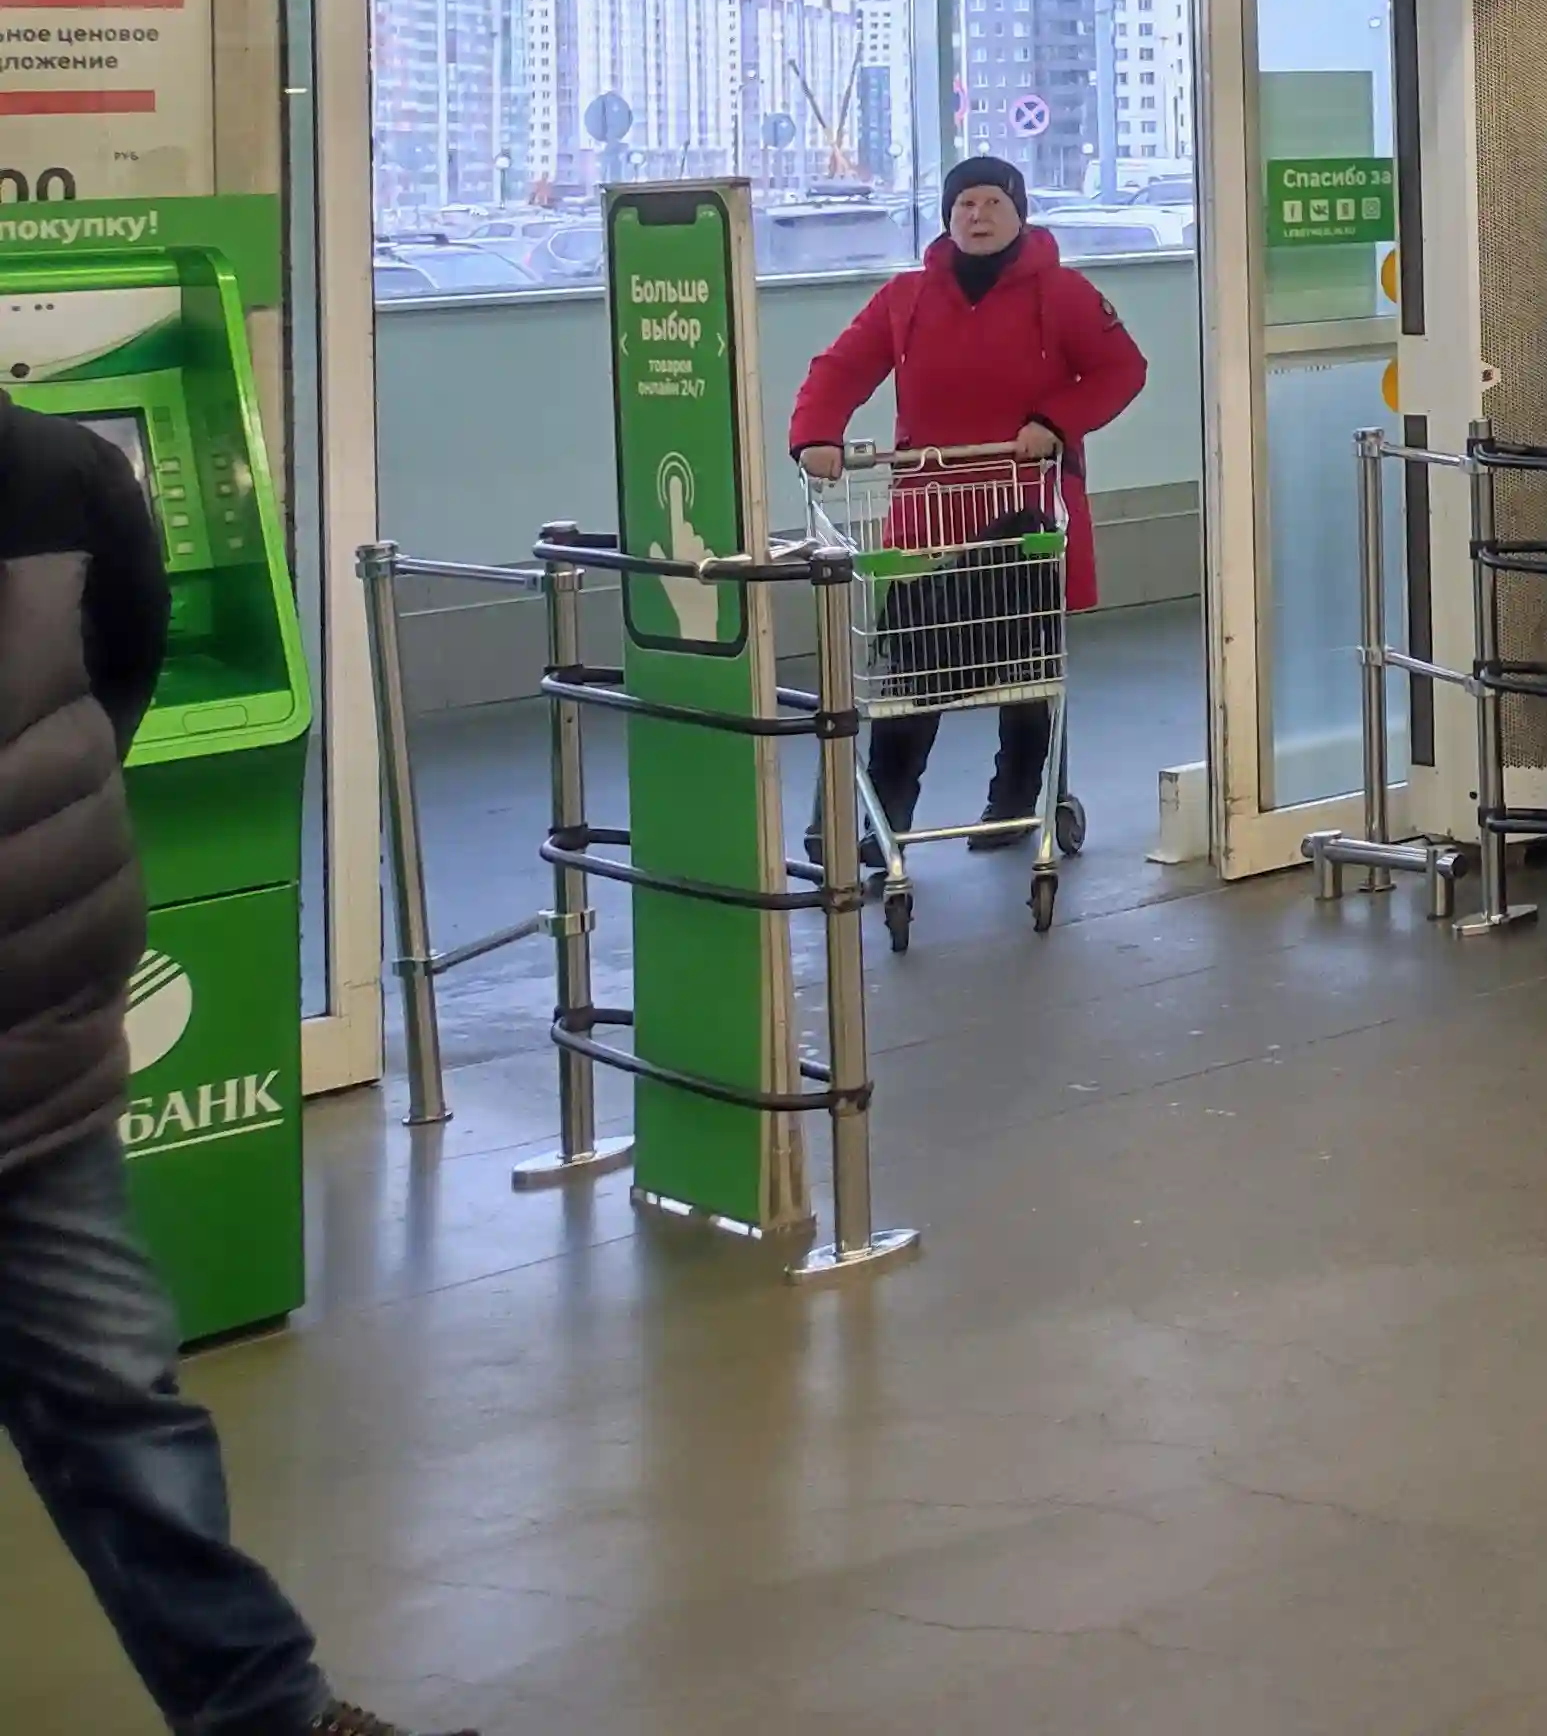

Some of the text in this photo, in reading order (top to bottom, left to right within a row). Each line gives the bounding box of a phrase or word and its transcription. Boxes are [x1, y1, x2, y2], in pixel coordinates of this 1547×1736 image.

[58, 28, 159, 46] ценовое
[0, 56, 118, 72] ложение
[1283, 164, 1392, 188] Спасибо за
[0, 210, 158, 244] покупку!
[631, 274, 709, 304] Больше
[641, 310, 701, 348] выбор
[681, 378, 705, 397] 24/7
